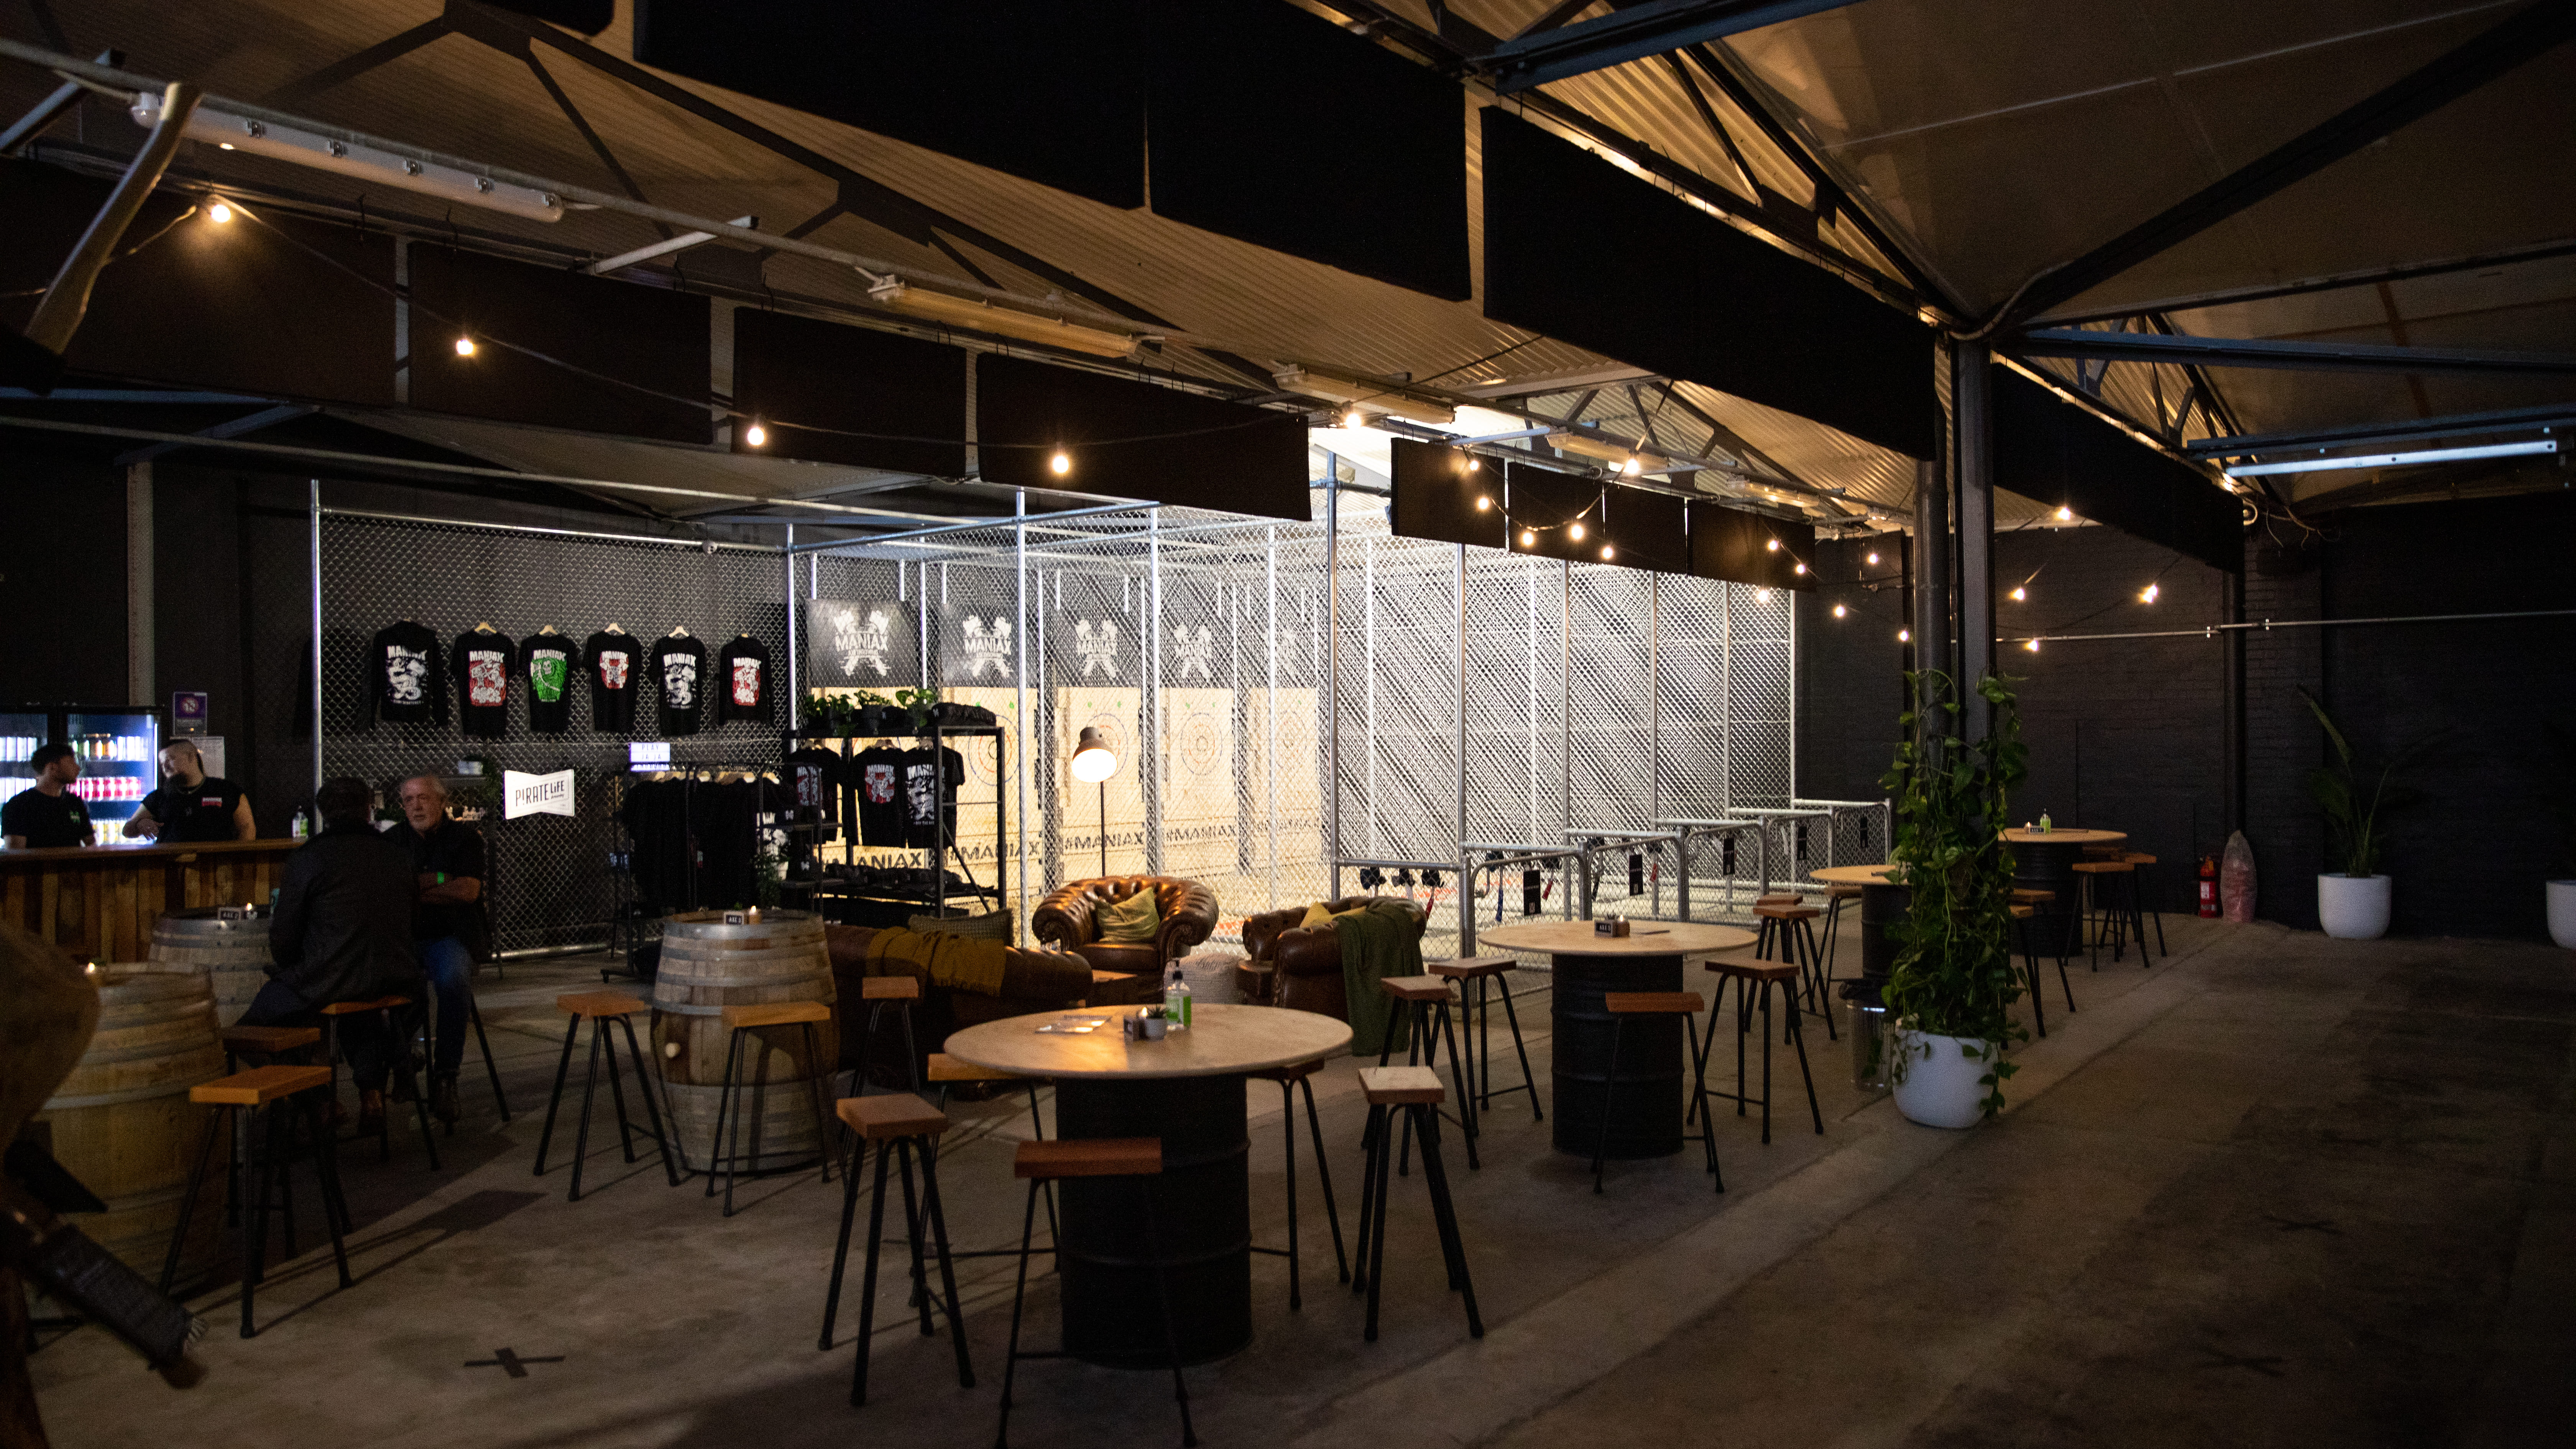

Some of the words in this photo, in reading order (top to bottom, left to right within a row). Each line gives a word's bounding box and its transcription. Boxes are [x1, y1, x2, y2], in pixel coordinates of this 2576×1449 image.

[835, 633, 889, 652] MANIAX
[964, 637, 1012, 655] MANIAX
[469, 650, 504, 663] MANIAX
[533, 649, 566, 661] MANIAX
[601, 651, 628, 662] MANIAX
[663, 653, 696, 667] MANIAX
[733, 657, 762, 669] MANIAX
[867, 764, 894, 775] MANIAX
[1065, 831, 1144, 850] #MANIAX
